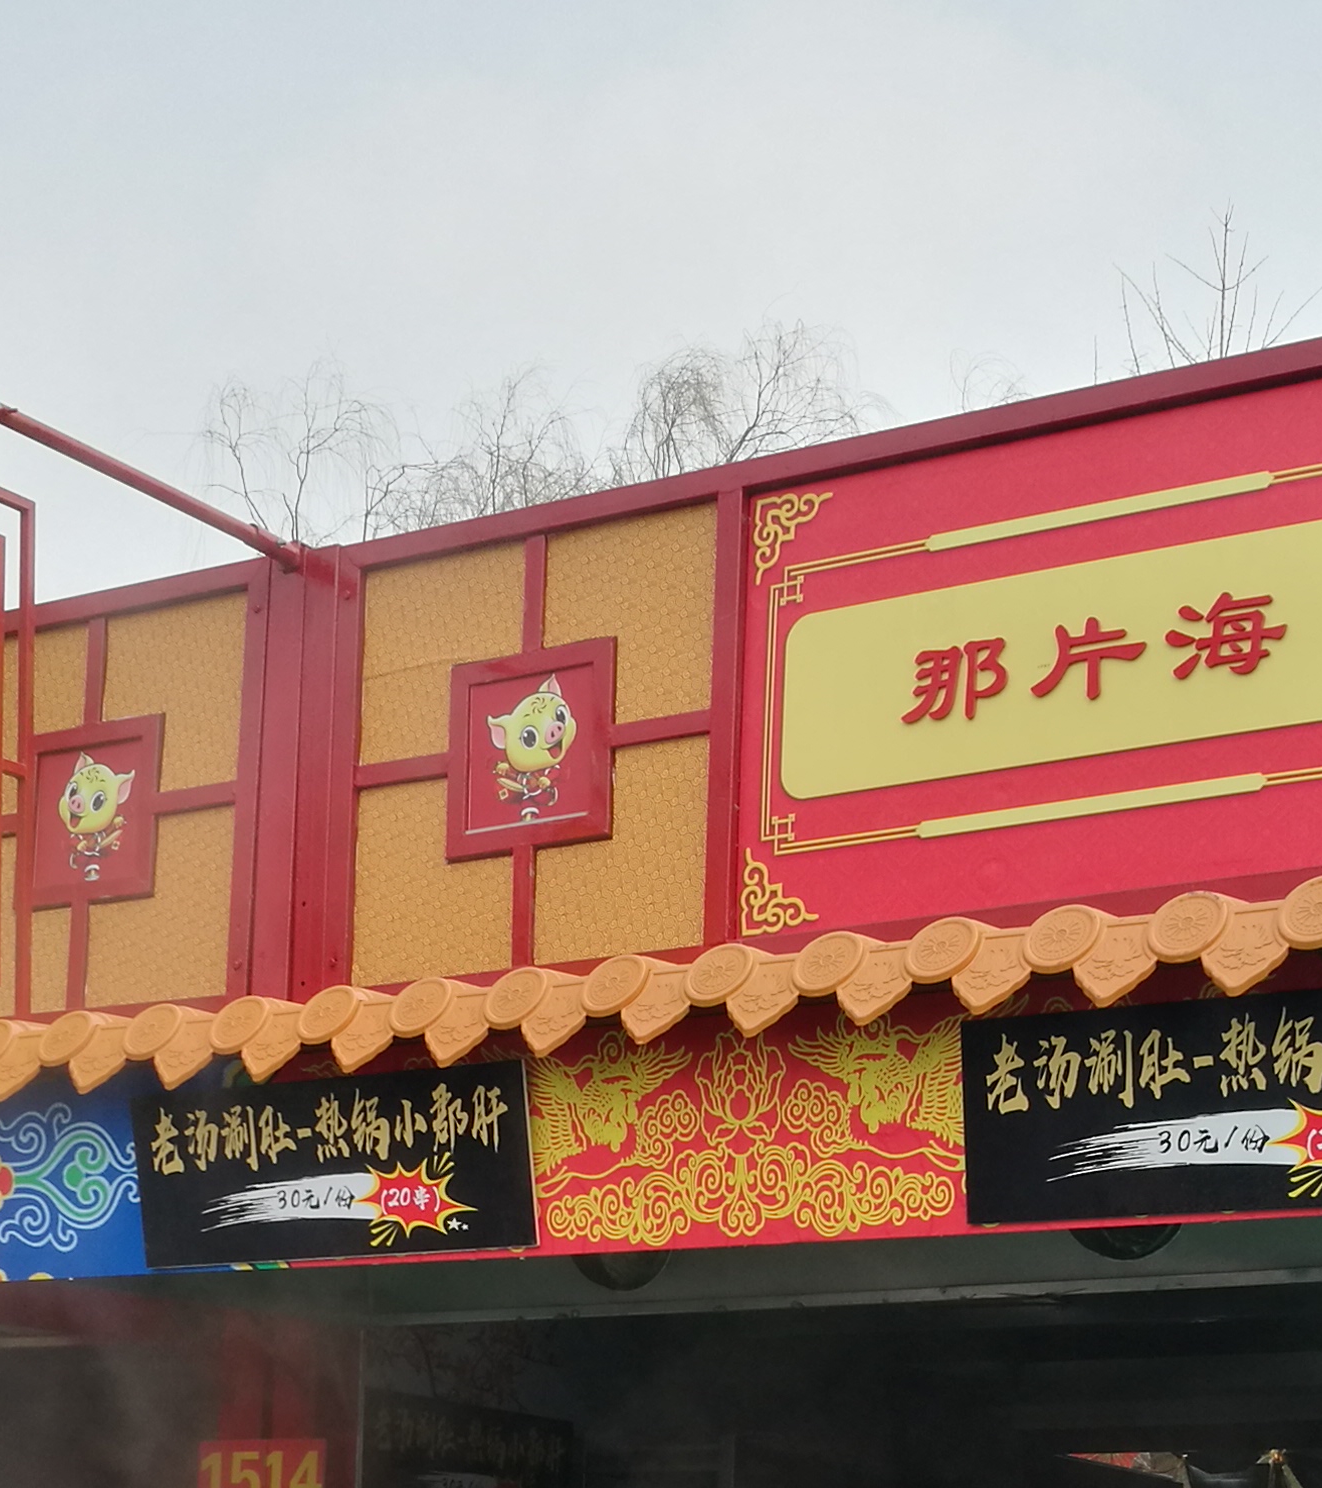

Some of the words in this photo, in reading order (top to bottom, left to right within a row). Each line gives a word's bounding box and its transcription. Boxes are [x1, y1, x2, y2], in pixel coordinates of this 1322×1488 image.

[900, 591, 1287, 725] 那片海
[1157, 1124, 1269, 1156] 30元/份
[276, 1187, 358, 1212] 30元/份
